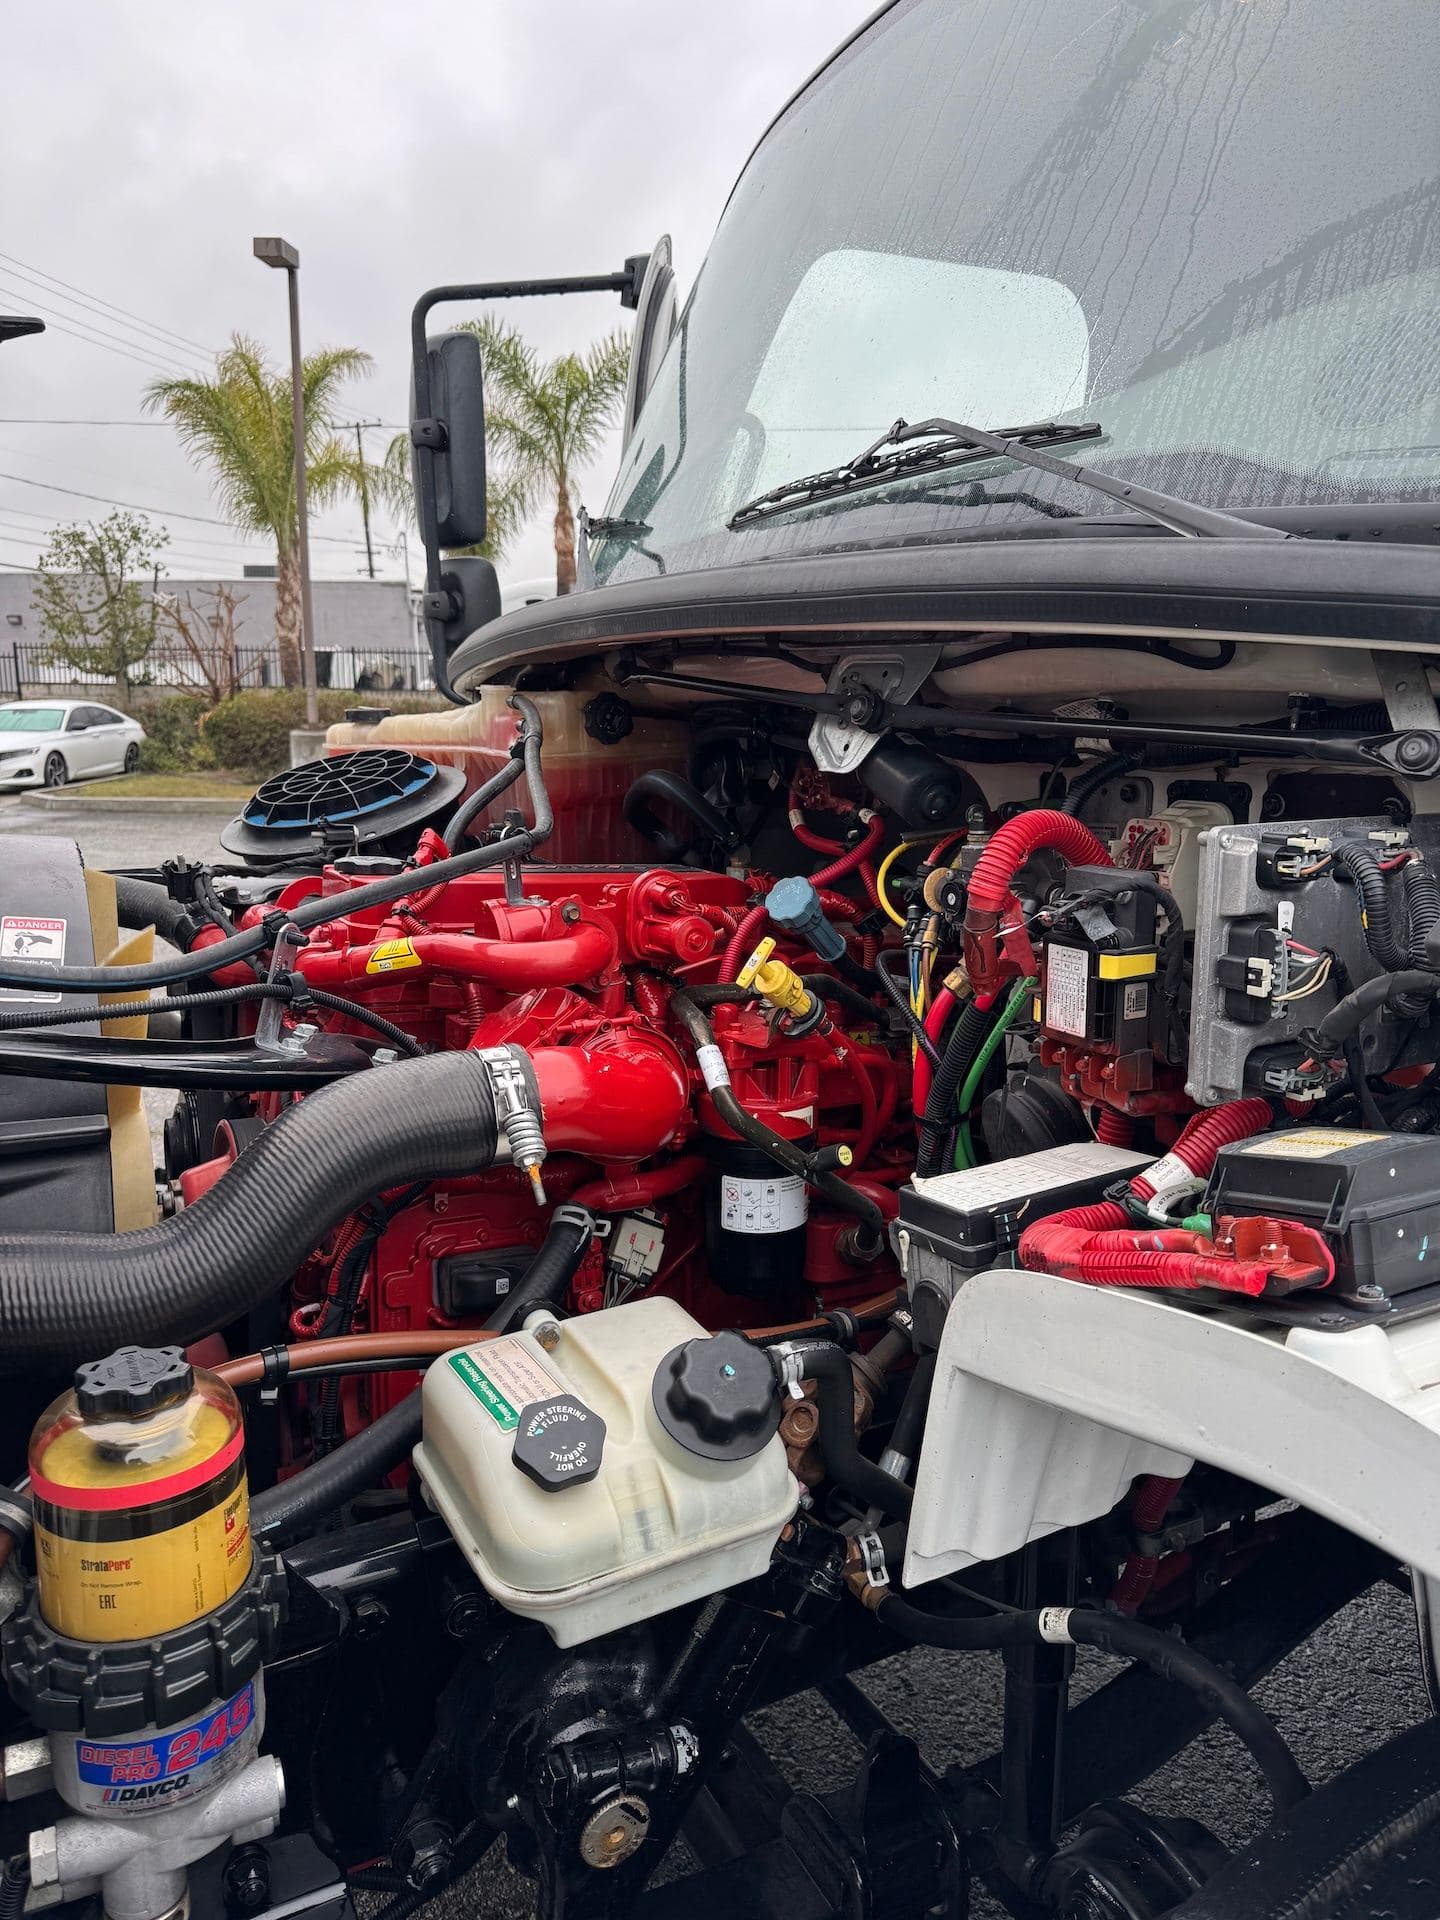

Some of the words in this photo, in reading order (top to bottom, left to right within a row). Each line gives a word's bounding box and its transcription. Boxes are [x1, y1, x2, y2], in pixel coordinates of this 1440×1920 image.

[18, 921, 62, 929] DANGER
[457, 1357, 481, 1383] Reservoir
[478, 1379, 500, 1405] Steering
[496, 1404, 512, 1422] Power
[527, 1412, 547, 1437] POWER
[546, 1405, 587, 1422] STEERING
[542, 1414, 569, 1429] FLUID
[549, 1441, 587, 1463] OVERFILL
[576, 1455, 588, 1468] DO
[556, 1462, 575, 1472] NOT
[110, 1761, 161, 1784] PRO
[165, 1691, 251, 1775] 245
[80, 1743, 160, 1766] DIESEL
[119, 1774, 189, 1802] DAVCO
